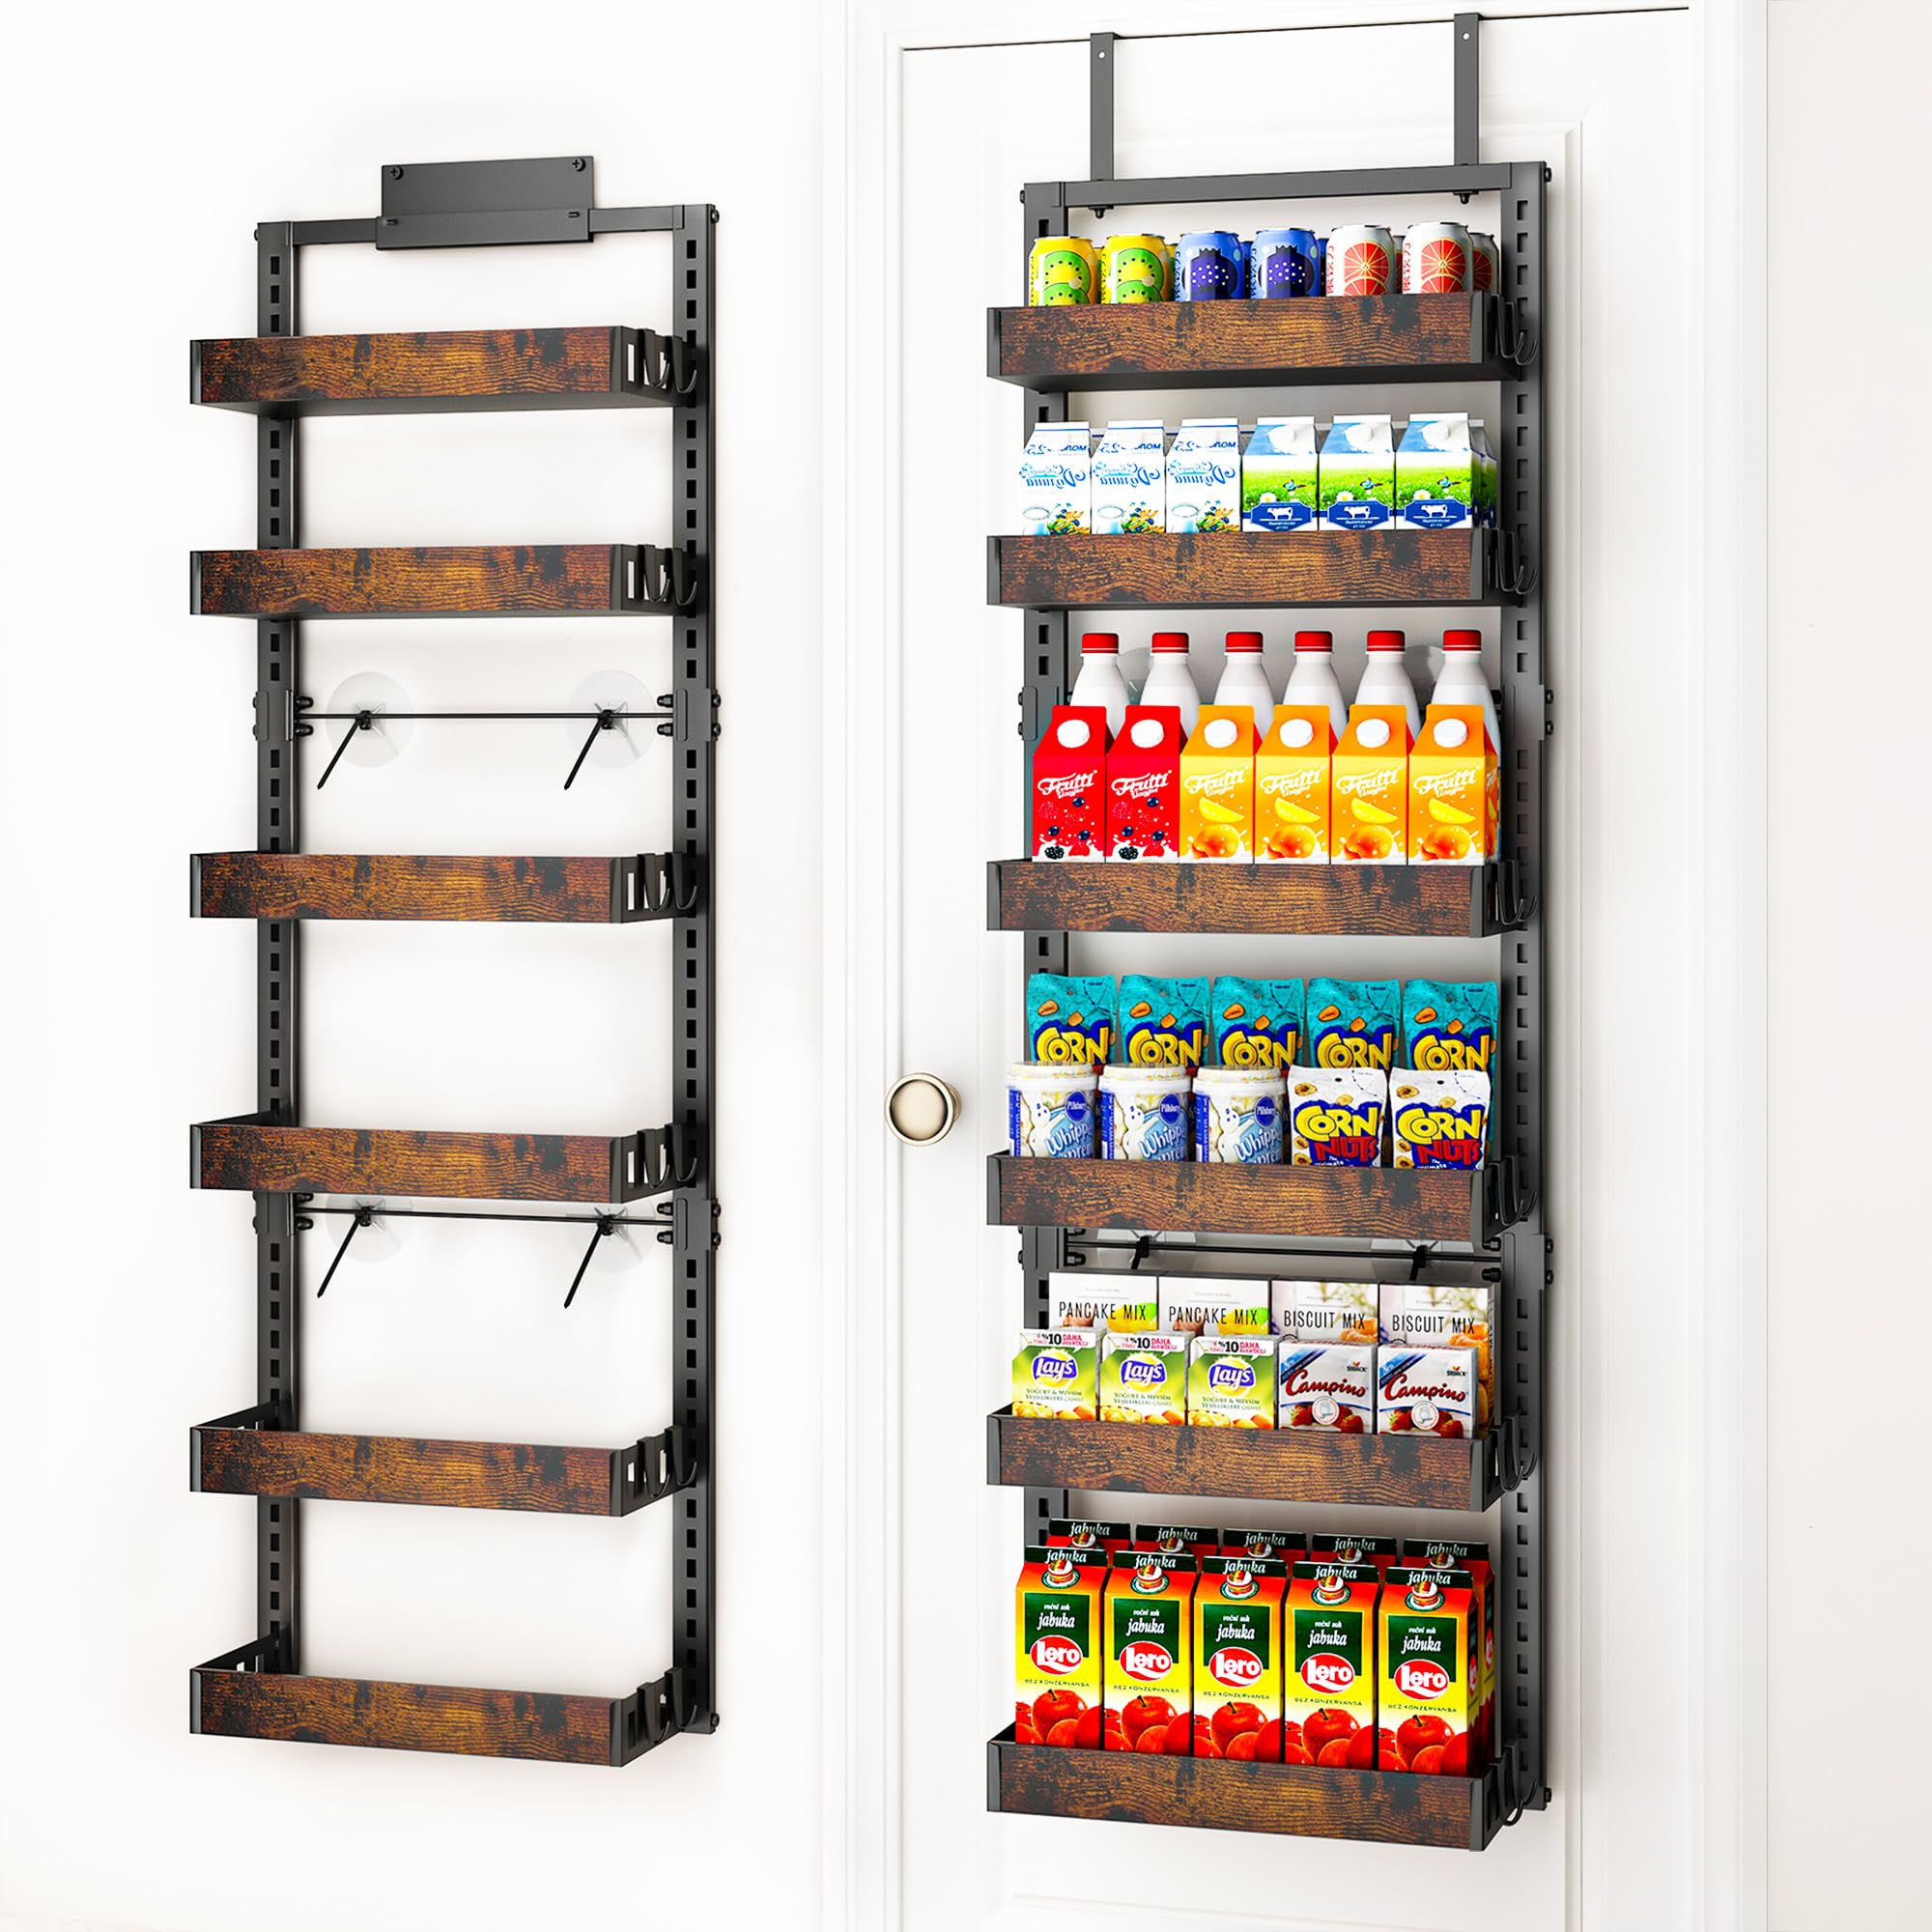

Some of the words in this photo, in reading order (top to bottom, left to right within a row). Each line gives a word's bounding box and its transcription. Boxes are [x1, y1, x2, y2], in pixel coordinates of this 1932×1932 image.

[1037, 769, 1097, 796] Frutti
[1111, 769, 1173, 796] Frutti
[1183, 765, 1249, 794] Frutti
[1260, 765, 1325, 794] Frutti
[1336, 765, 1403, 795] Frutti
[1413, 765, 1480, 795] Frutti
[1037, 1027, 1109, 1064] CORN
[1128, 1029, 1202, 1066] CORN
[1222, 1031, 1296, 1067] CORN
[1317, 1033, 1393, 1069] CORN
[1414, 1035, 1490, 1072] CORN
[1295, 1105, 1378, 1142] CORN
[1398, 1108, 1481, 1145] CORN
[1315, 1136, 1377, 1162] NUTS
[1416, 1139, 1480, 1165] NUTS
[1059, 1300, 1117, 1320] PANCAKE
[1123, 1304, 1147, 1321] MIX
[1169, 1305, 1227, 1324] PANCAKE
[1234, 1309, 1258, 1325] MIX
[1284, 1310, 1335, 1328] BISCUIT
[1342, 1313, 1365, 1329] MIX
[1392, 1315, 1445, 1333] BISCUIT
[1452, 1317, 1475, 1334] MIX
[1286, 1368, 1366, 1398] Campino
[1384, 1373, 1466, 1403] Campino
[1068, 1522, 1110, 1537] jabuka
[1155, 1527, 1198, 1543] jabuka
[1243, 1532, 1286, 1548] jabuka
[1044, 1549, 1087, 1564] jabuka
[1333, 1538, 1376, 1552] jabuka
[1424, 1543, 1467, 1558] jabuka
[1133, 1555, 1177, 1570] jabuka
[1222, 1560, 1265, 1575] jabuka
[1314, 1566, 1357, 1580] jabuka
[1406, 1571, 1451, 1586] jabuka
[1037, 1611, 1075, 1631] jabuka
[1125, 1617, 1165, 1636] jabuka
[1215, 1623, 1255, 1642] jabuka
[1307, 1629, 1348, 1648] jabuka
[1401, 1635, 1441, 1655] jabuka
[1037, 1640, 1081, 1667] Lero
[1125, 1647, 1170, 1672] Lero
[1215, 1653, 1261, 1679] Lero
[1307, 1660, 1352, 1685] Lero
[1401, 1665, 1447, 1691] Lero
